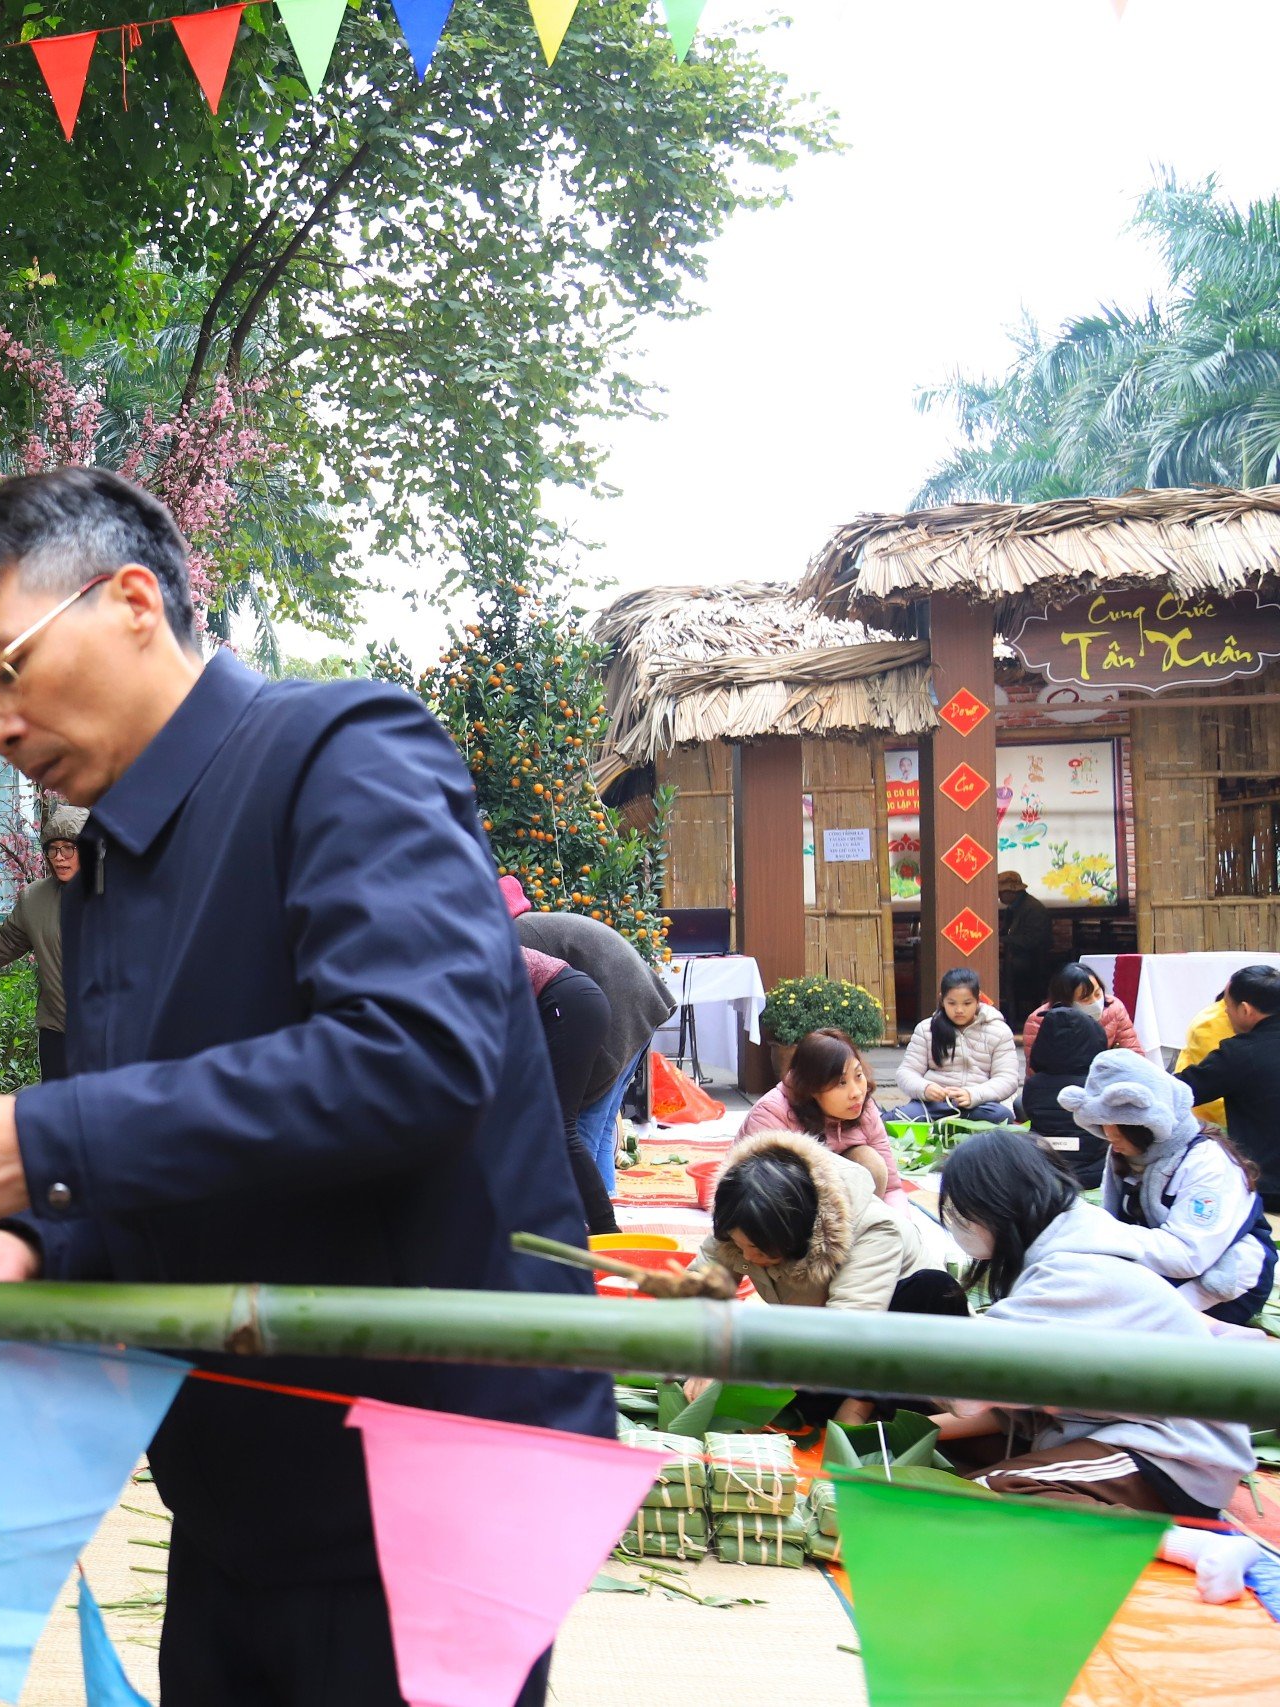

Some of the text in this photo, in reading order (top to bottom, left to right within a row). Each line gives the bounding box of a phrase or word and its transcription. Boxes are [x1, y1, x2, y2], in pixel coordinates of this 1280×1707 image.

[1088, 592, 1217, 656] Cung Chúc
[1061, 628, 1253, 680] Tân Xuân
